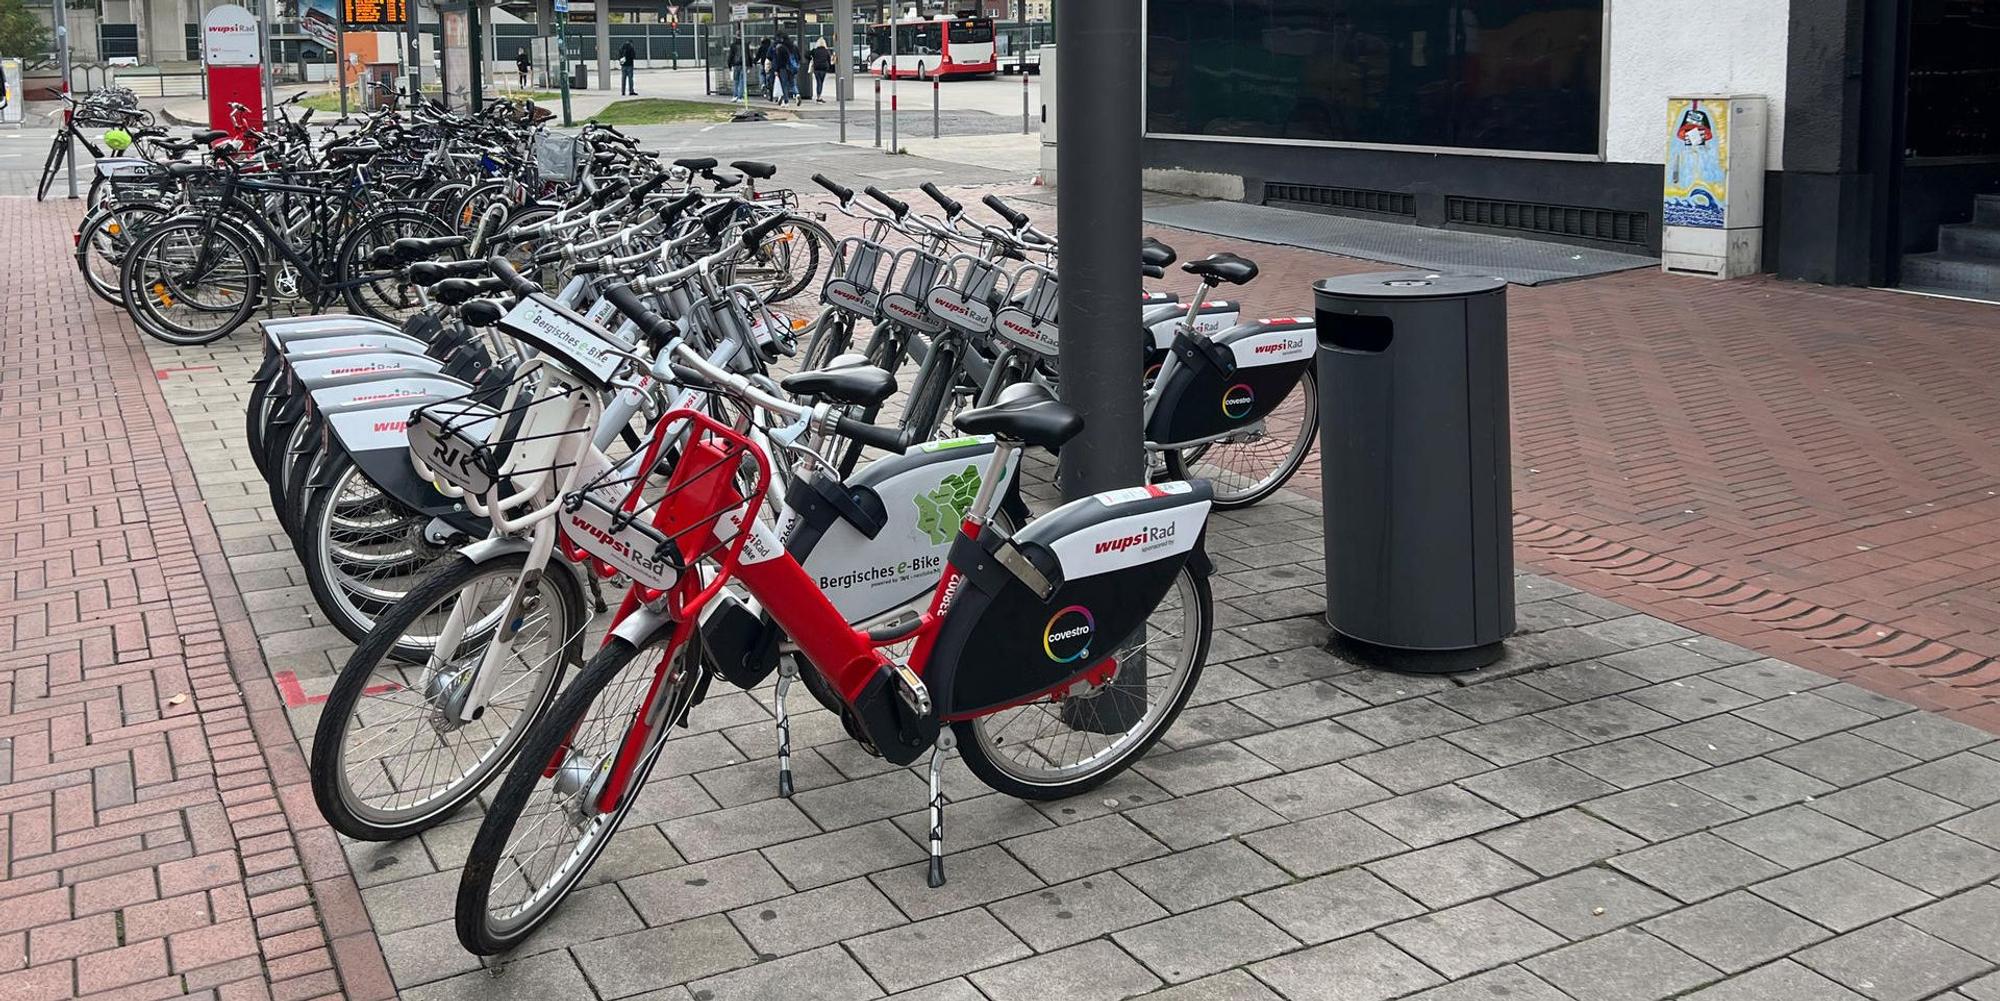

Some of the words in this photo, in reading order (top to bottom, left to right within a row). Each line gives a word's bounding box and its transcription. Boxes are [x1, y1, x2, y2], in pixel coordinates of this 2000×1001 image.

[571, 515, 665, 577] wupsiRad
[1095, 520, 1176, 554] wupsiRad
[819, 566, 895, 590] Bergisches
[896, 556, 941, 575] e-Bike
[1047, 625, 1090, 643] covestro
